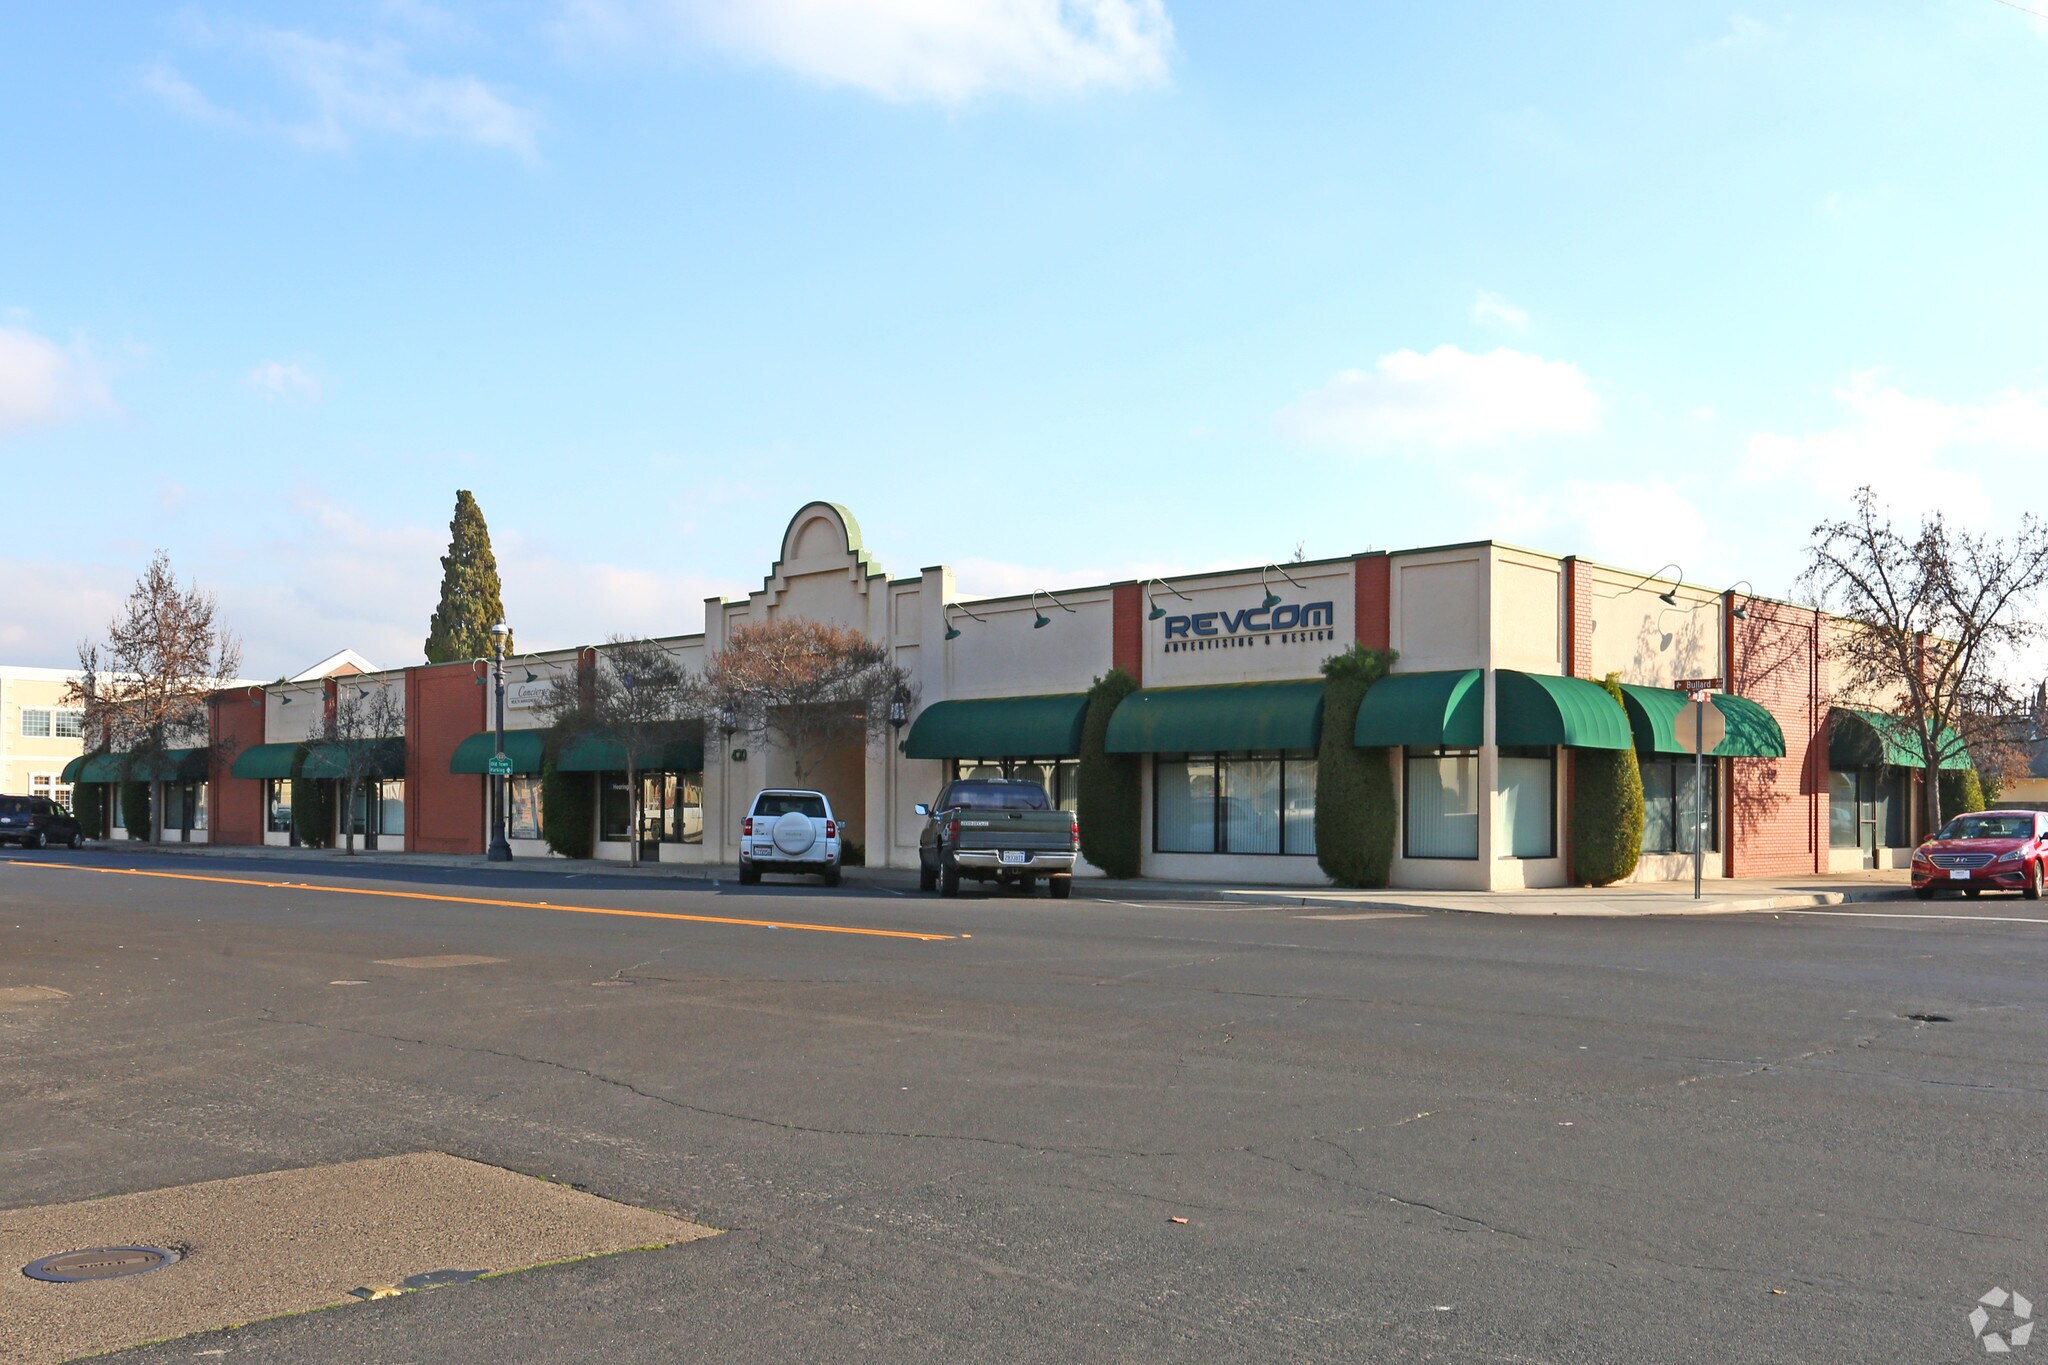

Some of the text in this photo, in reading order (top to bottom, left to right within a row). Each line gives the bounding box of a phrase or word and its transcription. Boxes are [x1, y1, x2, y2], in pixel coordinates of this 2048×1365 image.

[1164, 601, 1333, 639] REVCOM
[1164, 630, 1334, 653] ADVERTISING & DESIGN
[1686, 680, 1712, 689] Bullard
